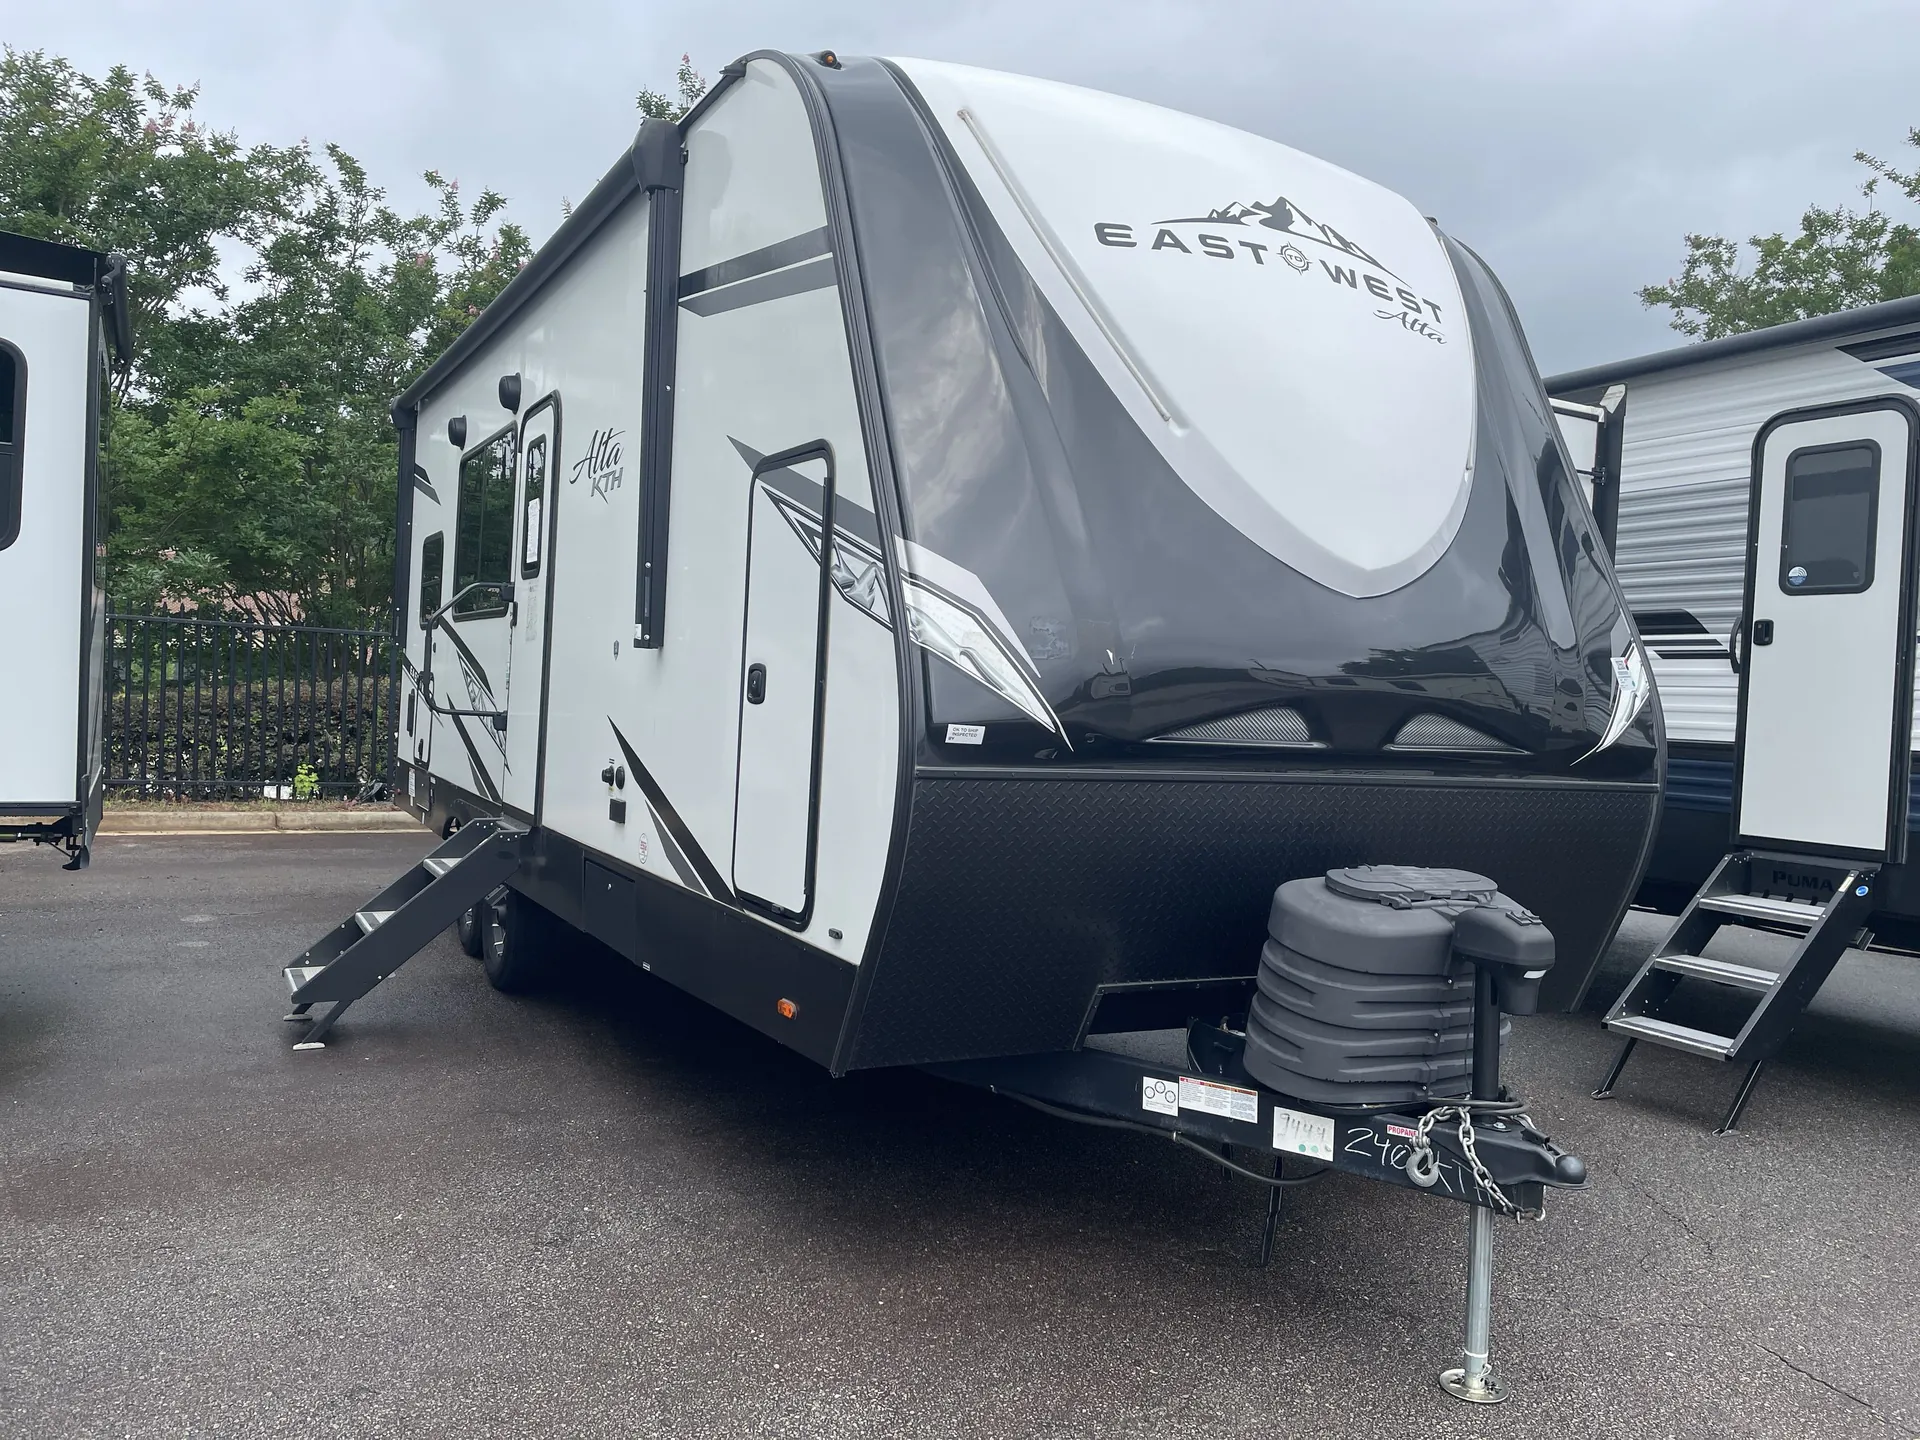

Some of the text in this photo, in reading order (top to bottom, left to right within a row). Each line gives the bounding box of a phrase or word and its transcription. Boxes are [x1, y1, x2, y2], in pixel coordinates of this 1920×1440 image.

[1094, 222, 1442, 324] EAST TO WEST
[1373, 309, 1447, 345] Alta
[569, 427, 626, 485] Alta
[590, 467, 624, 505] KTH
[1772, 870, 1834, 892] PUMA
[1387, 1125, 1418, 1138] PROPANE
